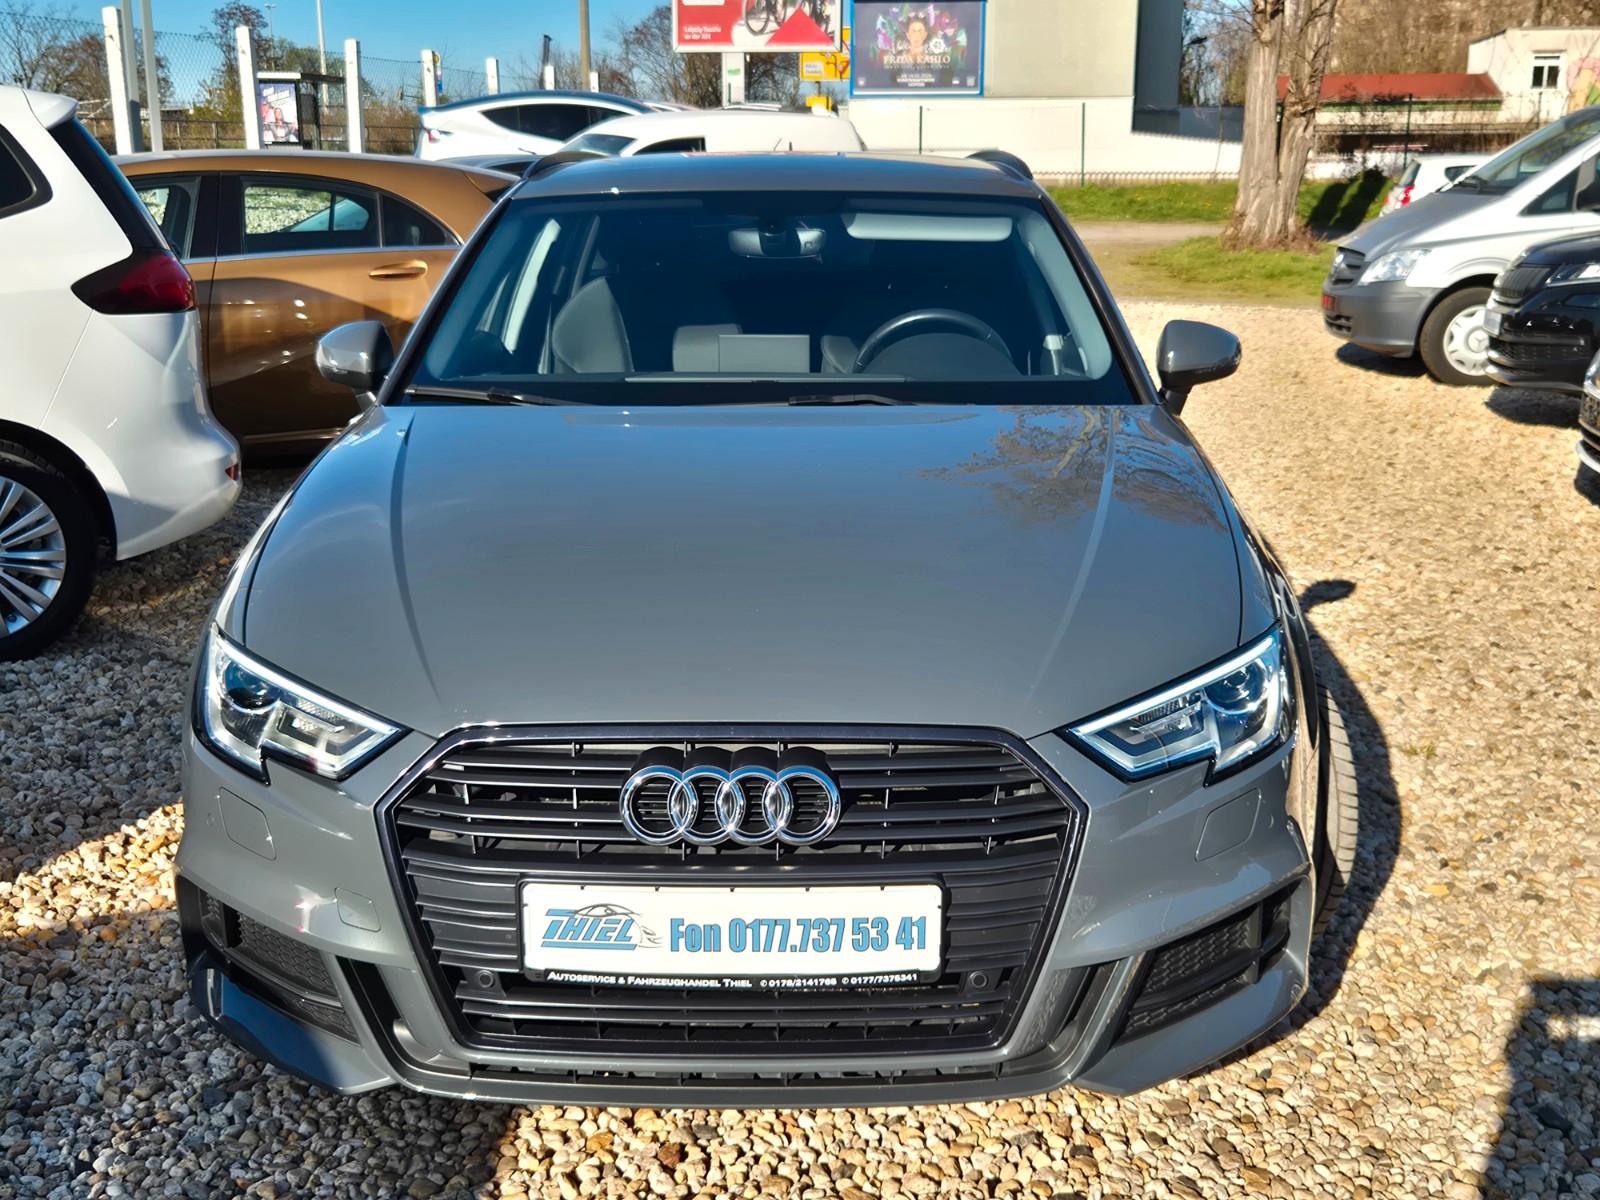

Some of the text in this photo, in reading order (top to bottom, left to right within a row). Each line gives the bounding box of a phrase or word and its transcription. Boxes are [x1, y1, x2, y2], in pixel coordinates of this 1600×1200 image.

[883, 55, 951, 65] FRIDA KAHLO
[542, 908, 635, 942] THIEL
[670, 916, 927, 953] Fon 0177.737 53 41
[547, 971, 752, 988] AUTOSERVICE & FAHRZEUGHANDEL THIEL
